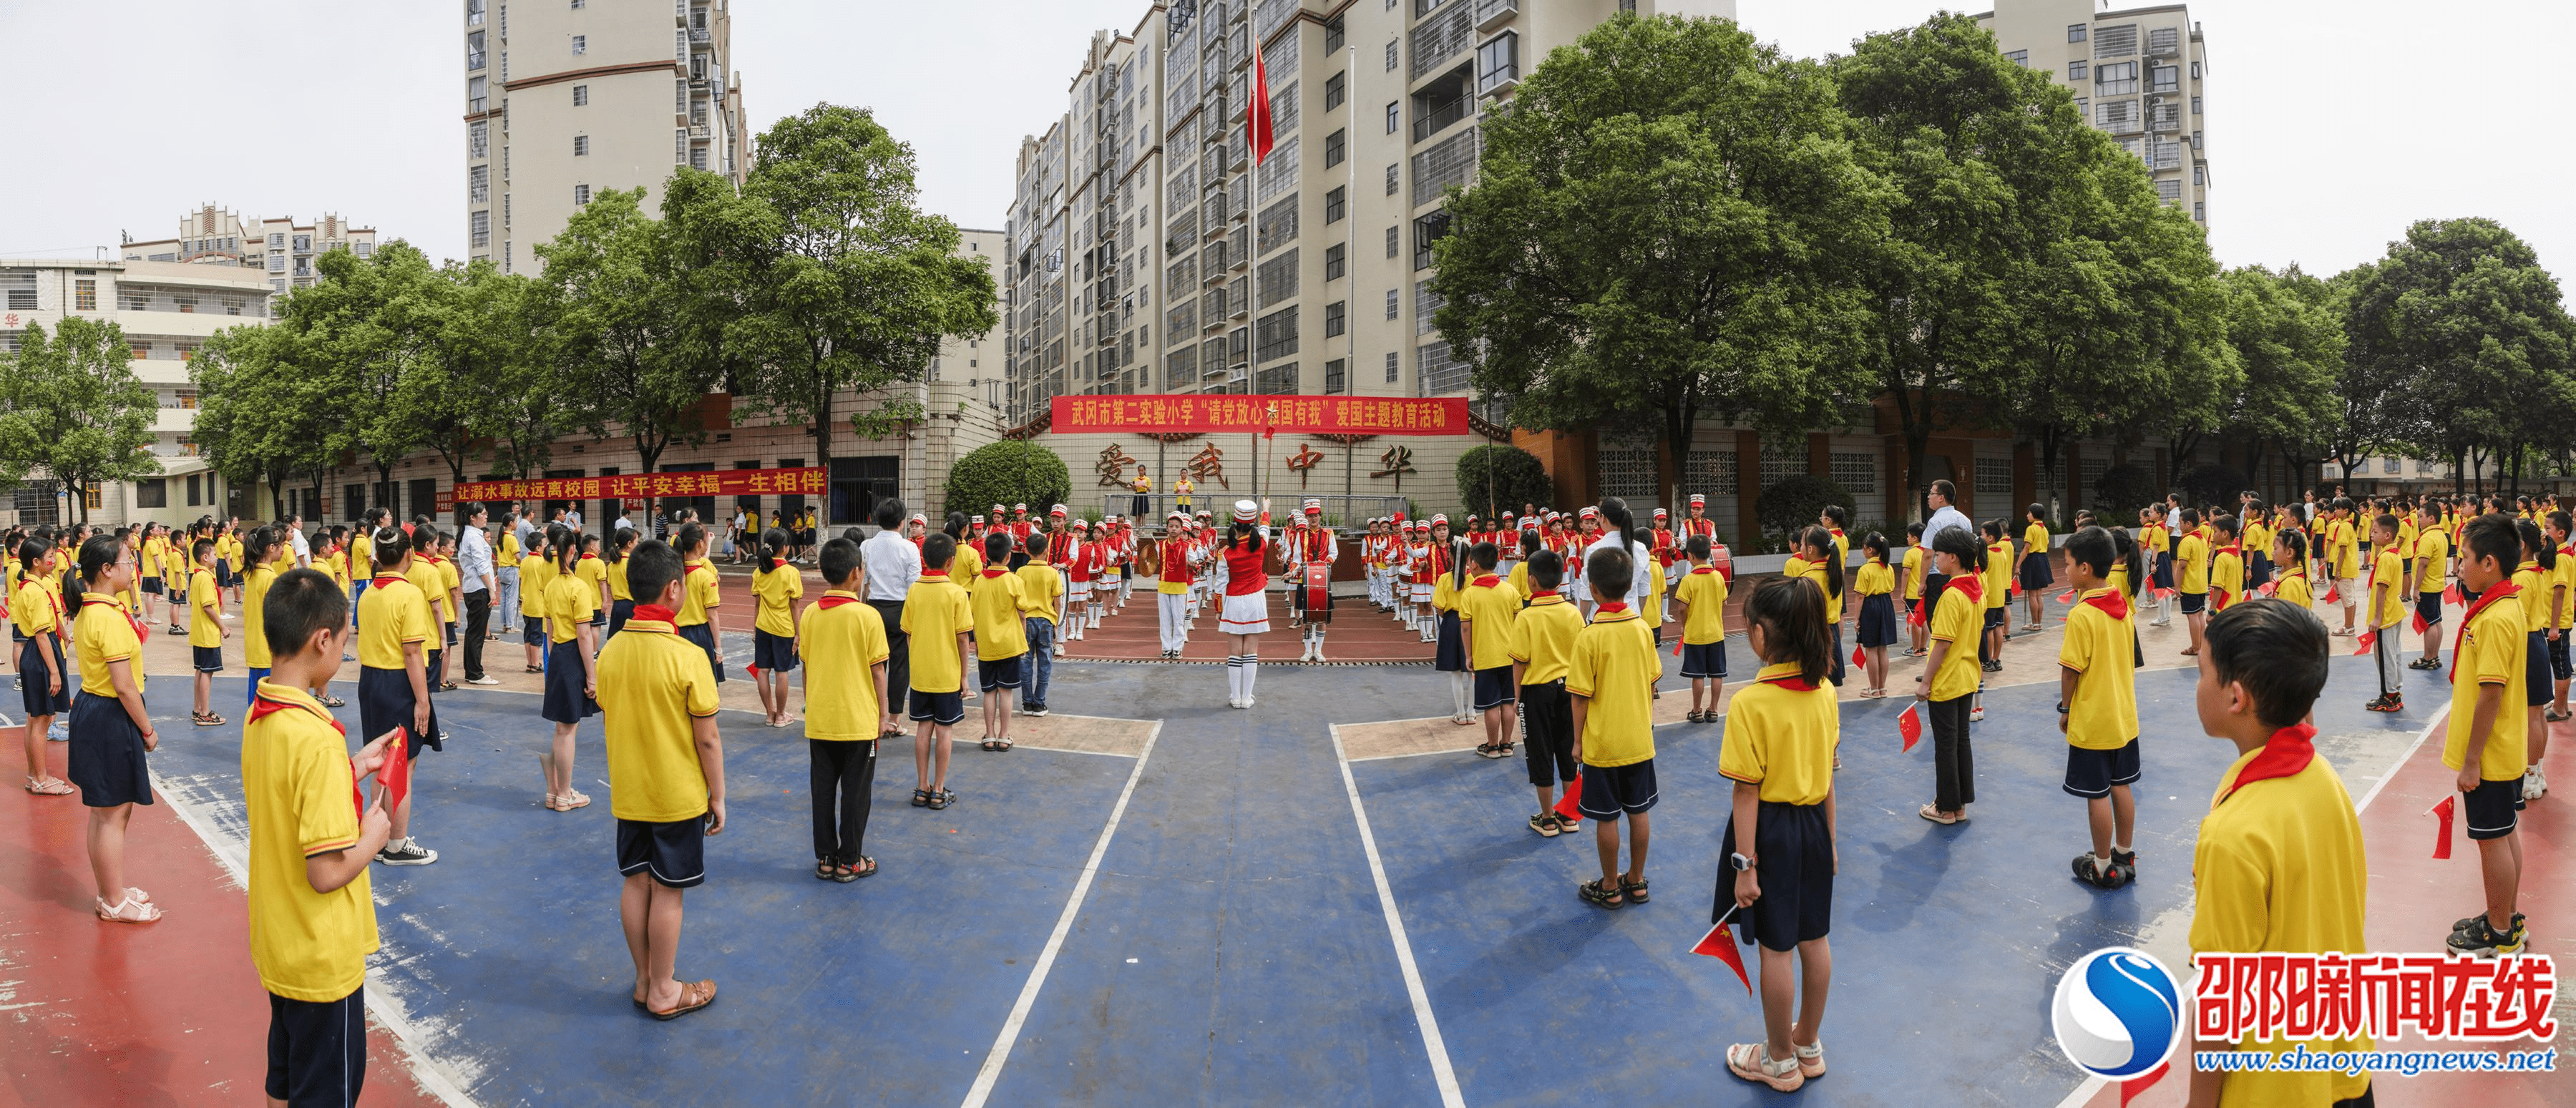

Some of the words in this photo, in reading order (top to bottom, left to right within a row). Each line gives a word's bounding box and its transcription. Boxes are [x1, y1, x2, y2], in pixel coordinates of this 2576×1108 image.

[5, 313, 19, 328] 华
[457, 480, 600, 500] 让溺水事故远离校园
[610, 469, 825, 496] 让平安幸福一生相伴
